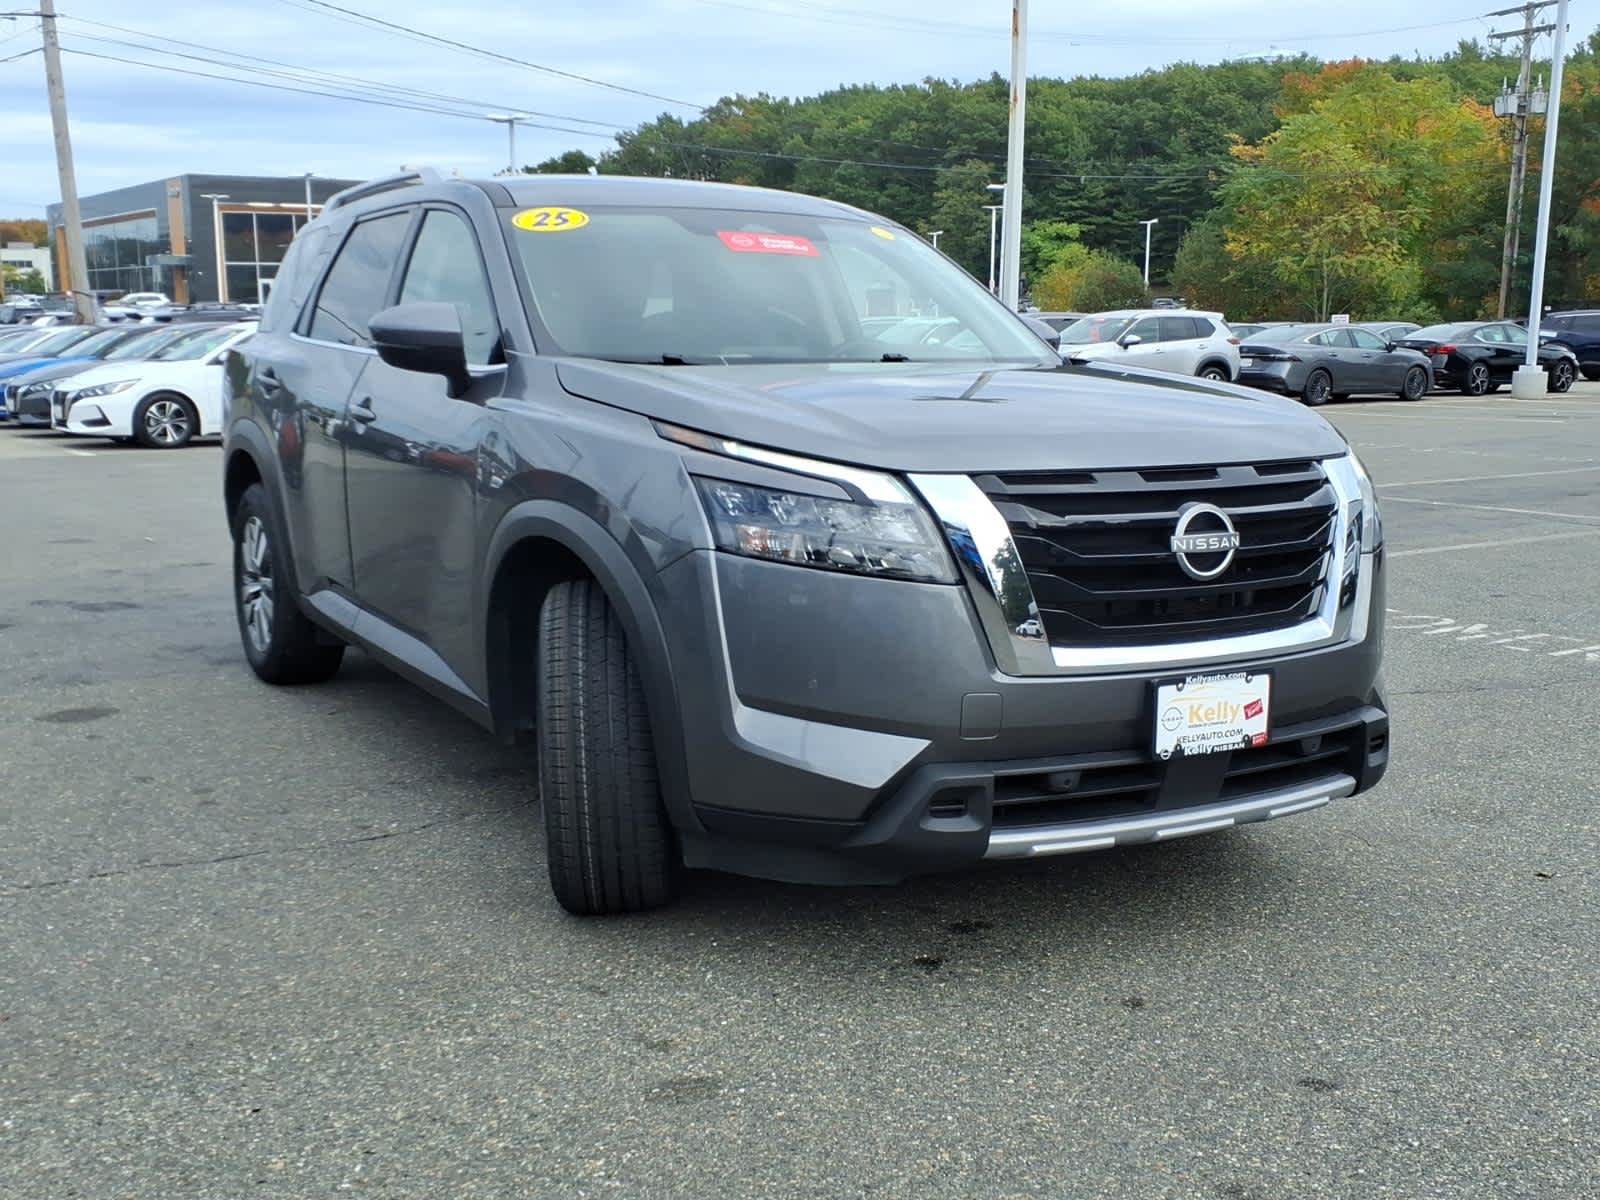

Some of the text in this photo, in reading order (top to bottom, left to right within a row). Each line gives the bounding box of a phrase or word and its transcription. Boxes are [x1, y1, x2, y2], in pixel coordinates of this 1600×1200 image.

[533, 211, 571, 227] 25
[1173, 536, 1240, 551] NISSAN
[1185, 672, 1247, 686] Kellyauto.com
[1187, 701, 1240, 724] Kelly
[1176, 729, 1244, 744] KELLYAUTO.COM
[1184, 742, 1246, 756] Kelly NISSAN
